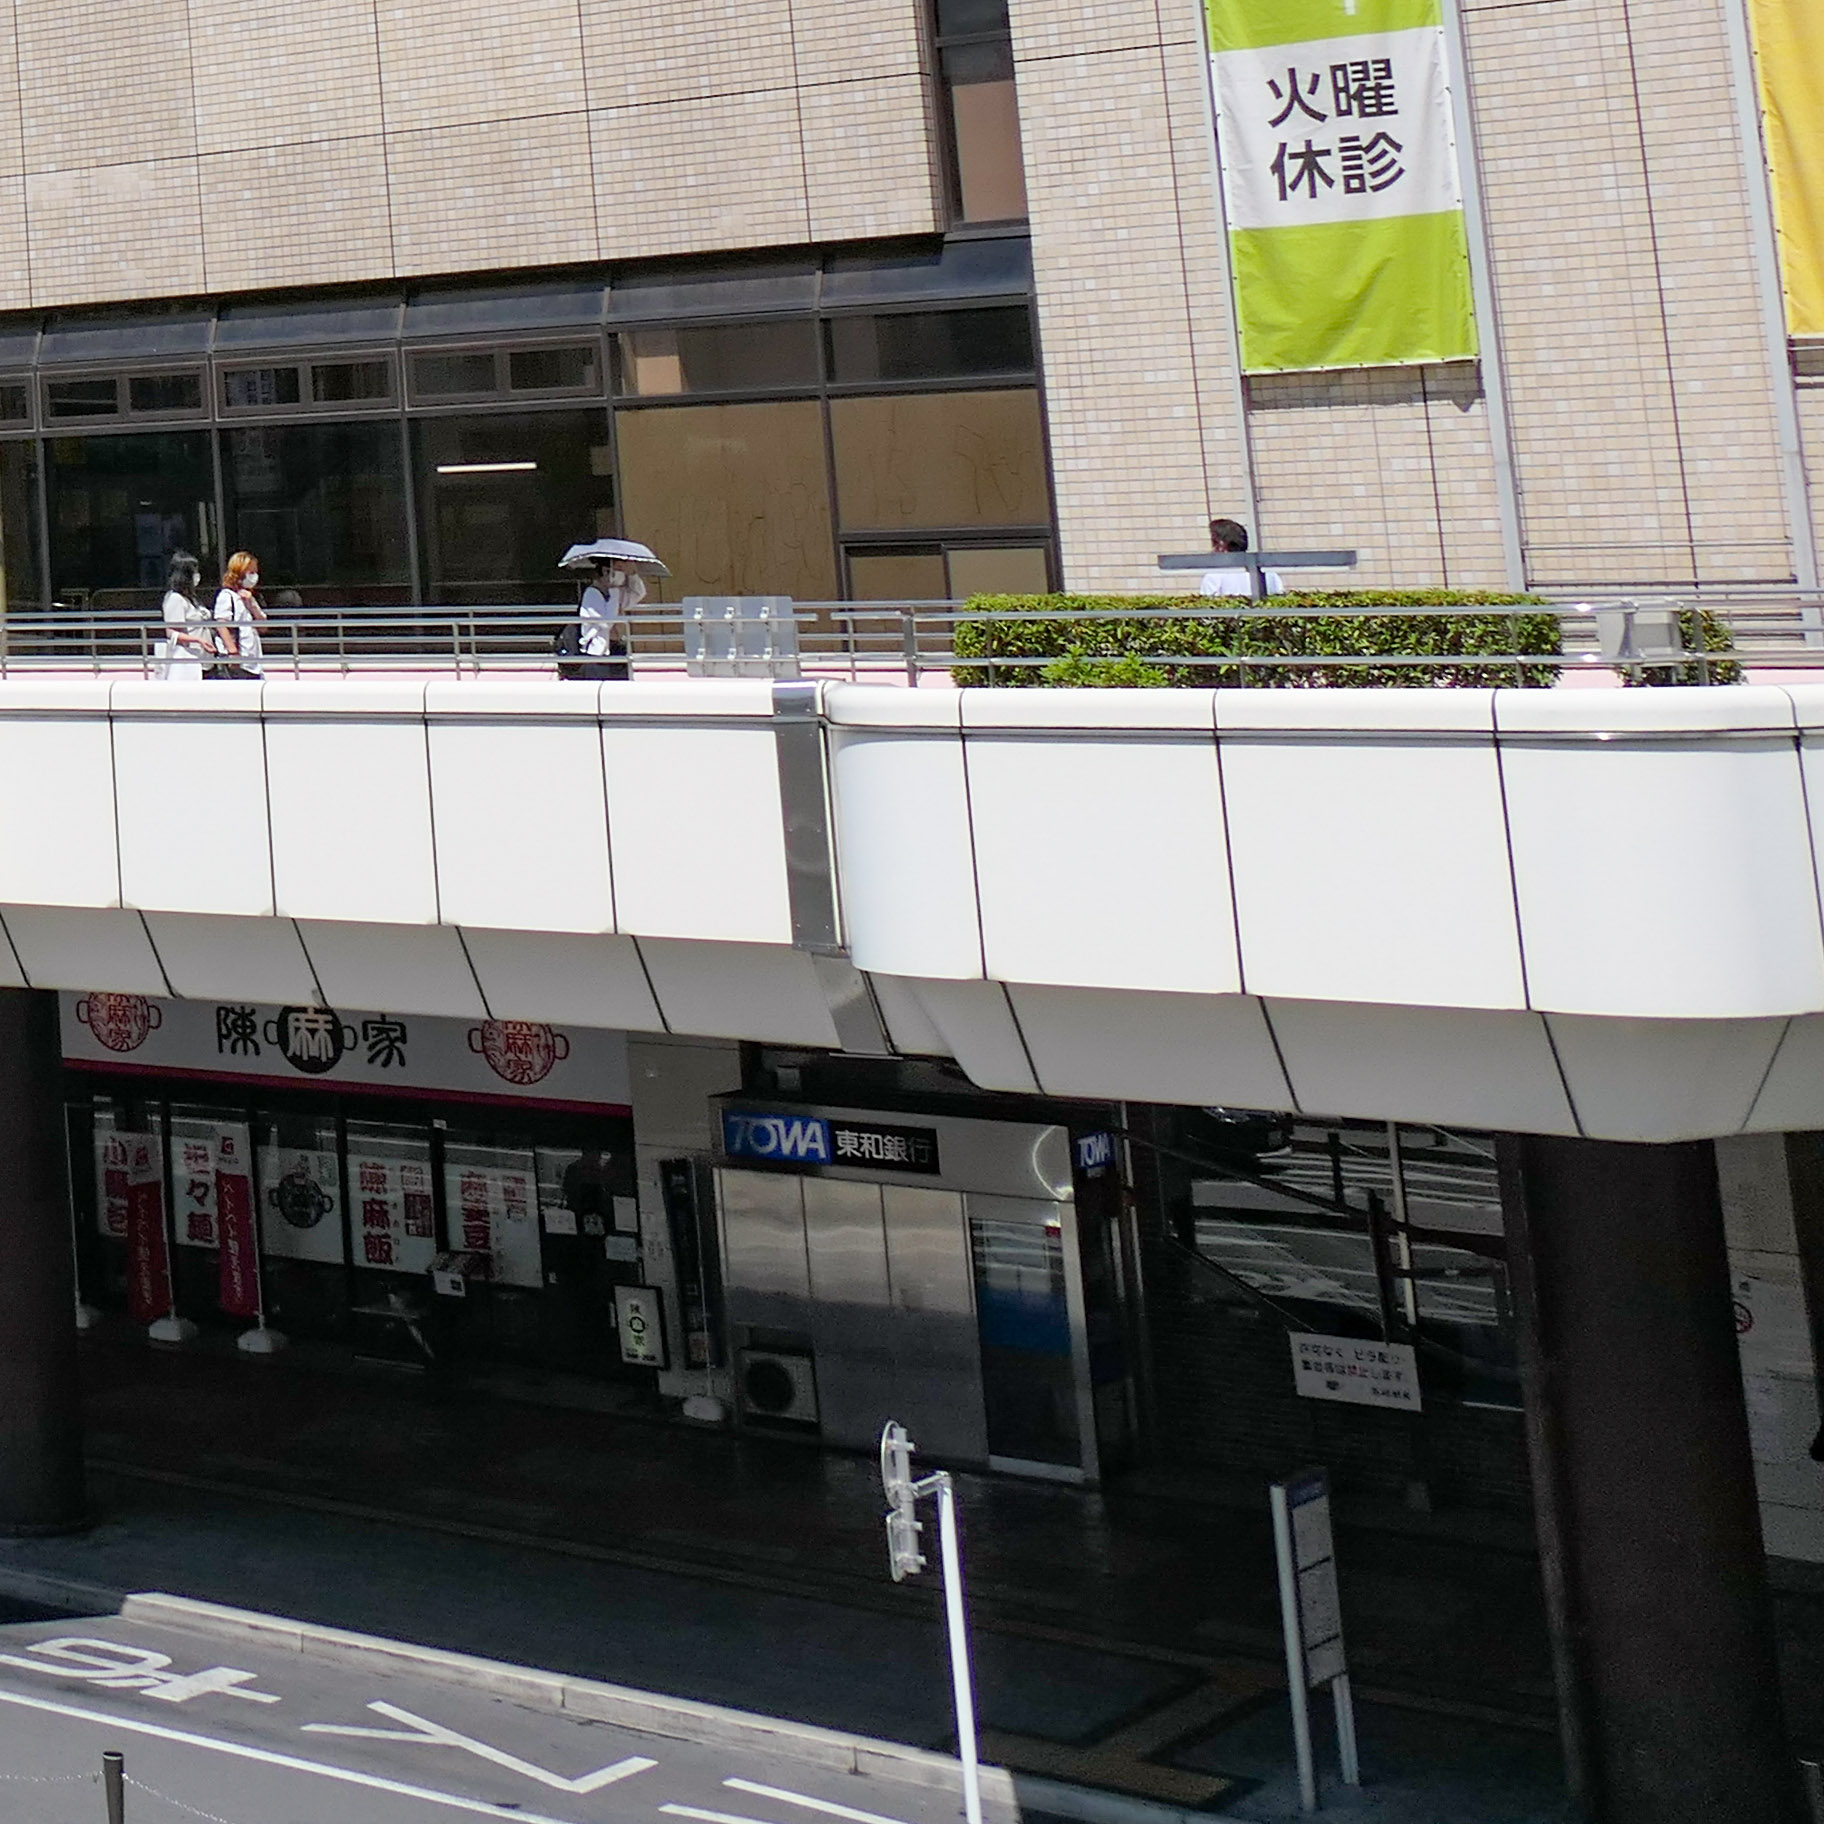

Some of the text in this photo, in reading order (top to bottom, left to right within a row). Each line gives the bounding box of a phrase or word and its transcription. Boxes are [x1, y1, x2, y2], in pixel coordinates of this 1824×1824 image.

[1265, 55, 1400, 130] 火曜
[1270, 127, 1407, 205] 休診
[216, 1003, 408, 1069] 陳麻家
[727, 1112, 827, 1160] TOWA
[835, 1128, 934, 1167] 東和銀行
